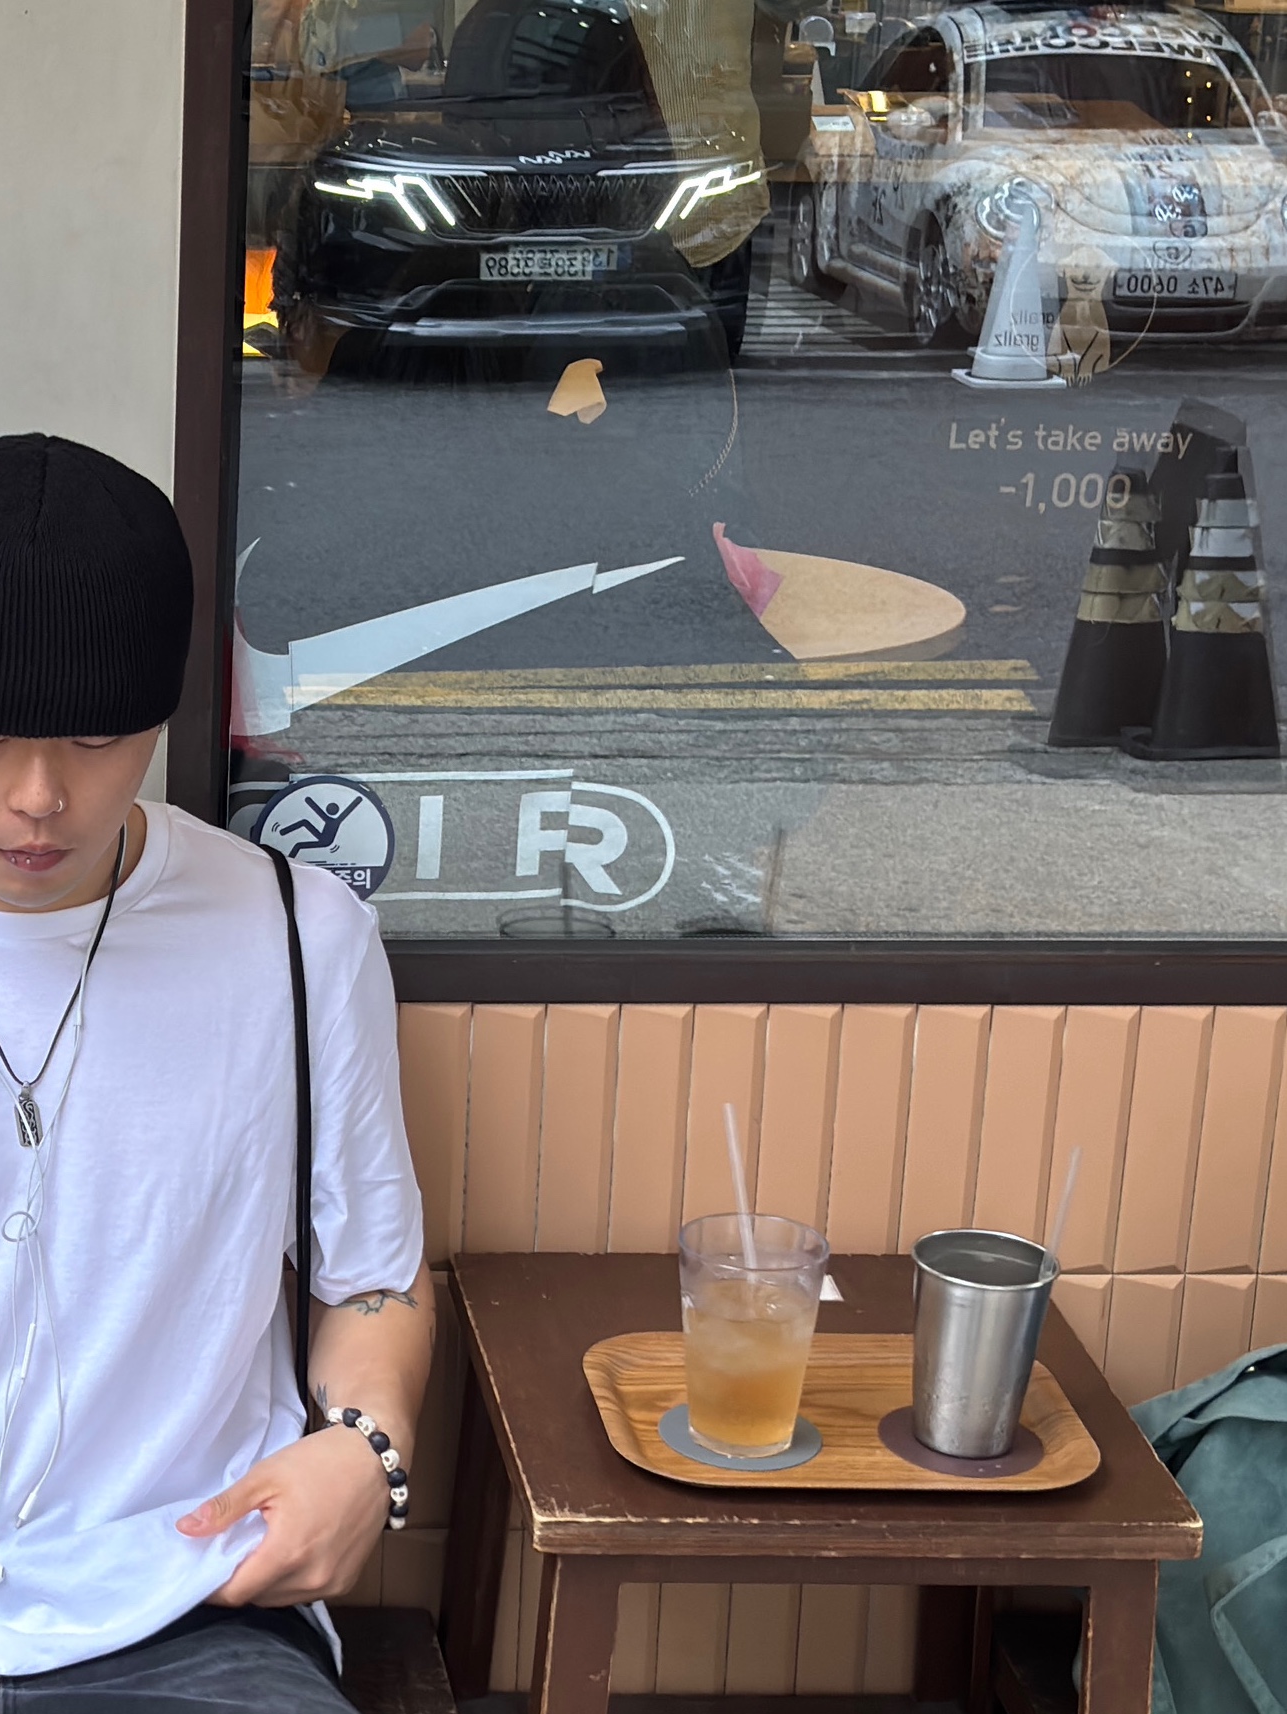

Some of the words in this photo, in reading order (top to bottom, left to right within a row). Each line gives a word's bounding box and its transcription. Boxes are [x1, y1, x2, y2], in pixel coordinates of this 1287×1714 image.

[948, 417, 1023, 450] Let's
[1034, 423, 1102, 451] take
[1112, 429, 1194, 460] away
[998, 472, 1132, 514] -1,000
